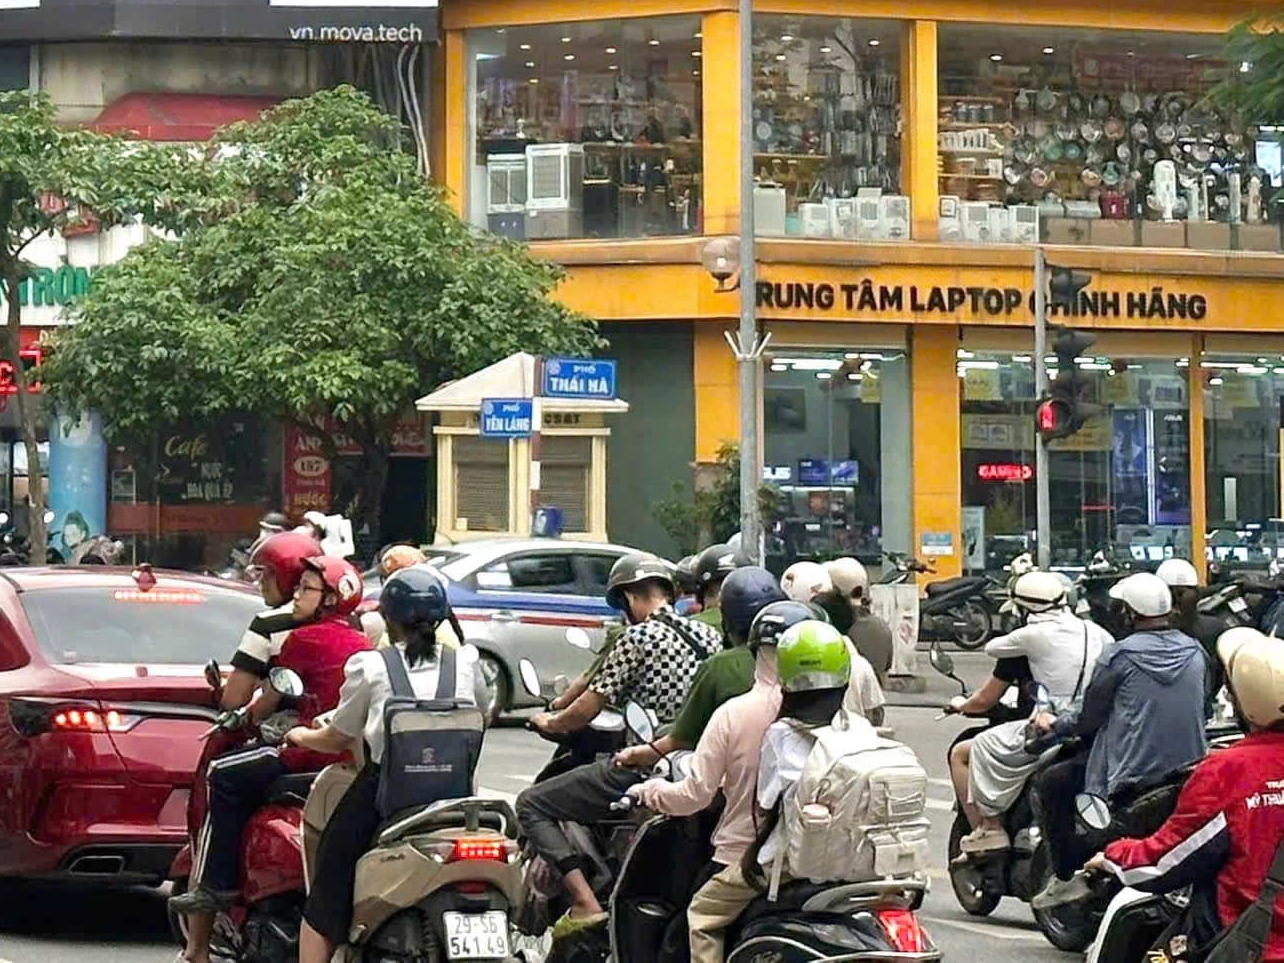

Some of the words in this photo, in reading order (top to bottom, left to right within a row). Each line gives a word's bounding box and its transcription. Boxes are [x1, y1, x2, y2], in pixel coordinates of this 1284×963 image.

[289, 23, 422, 42] vn.mova.tech
[840, 277, 903, 312] TÂM
[910, 285, 1022, 315] LAPTOP
[573, 363, 596, 373] PHỐ
[549, 376, 585, 392] THÁI
[588, 376, 609, 393] HÀ
[485, 415, 504, 431] YÊN
